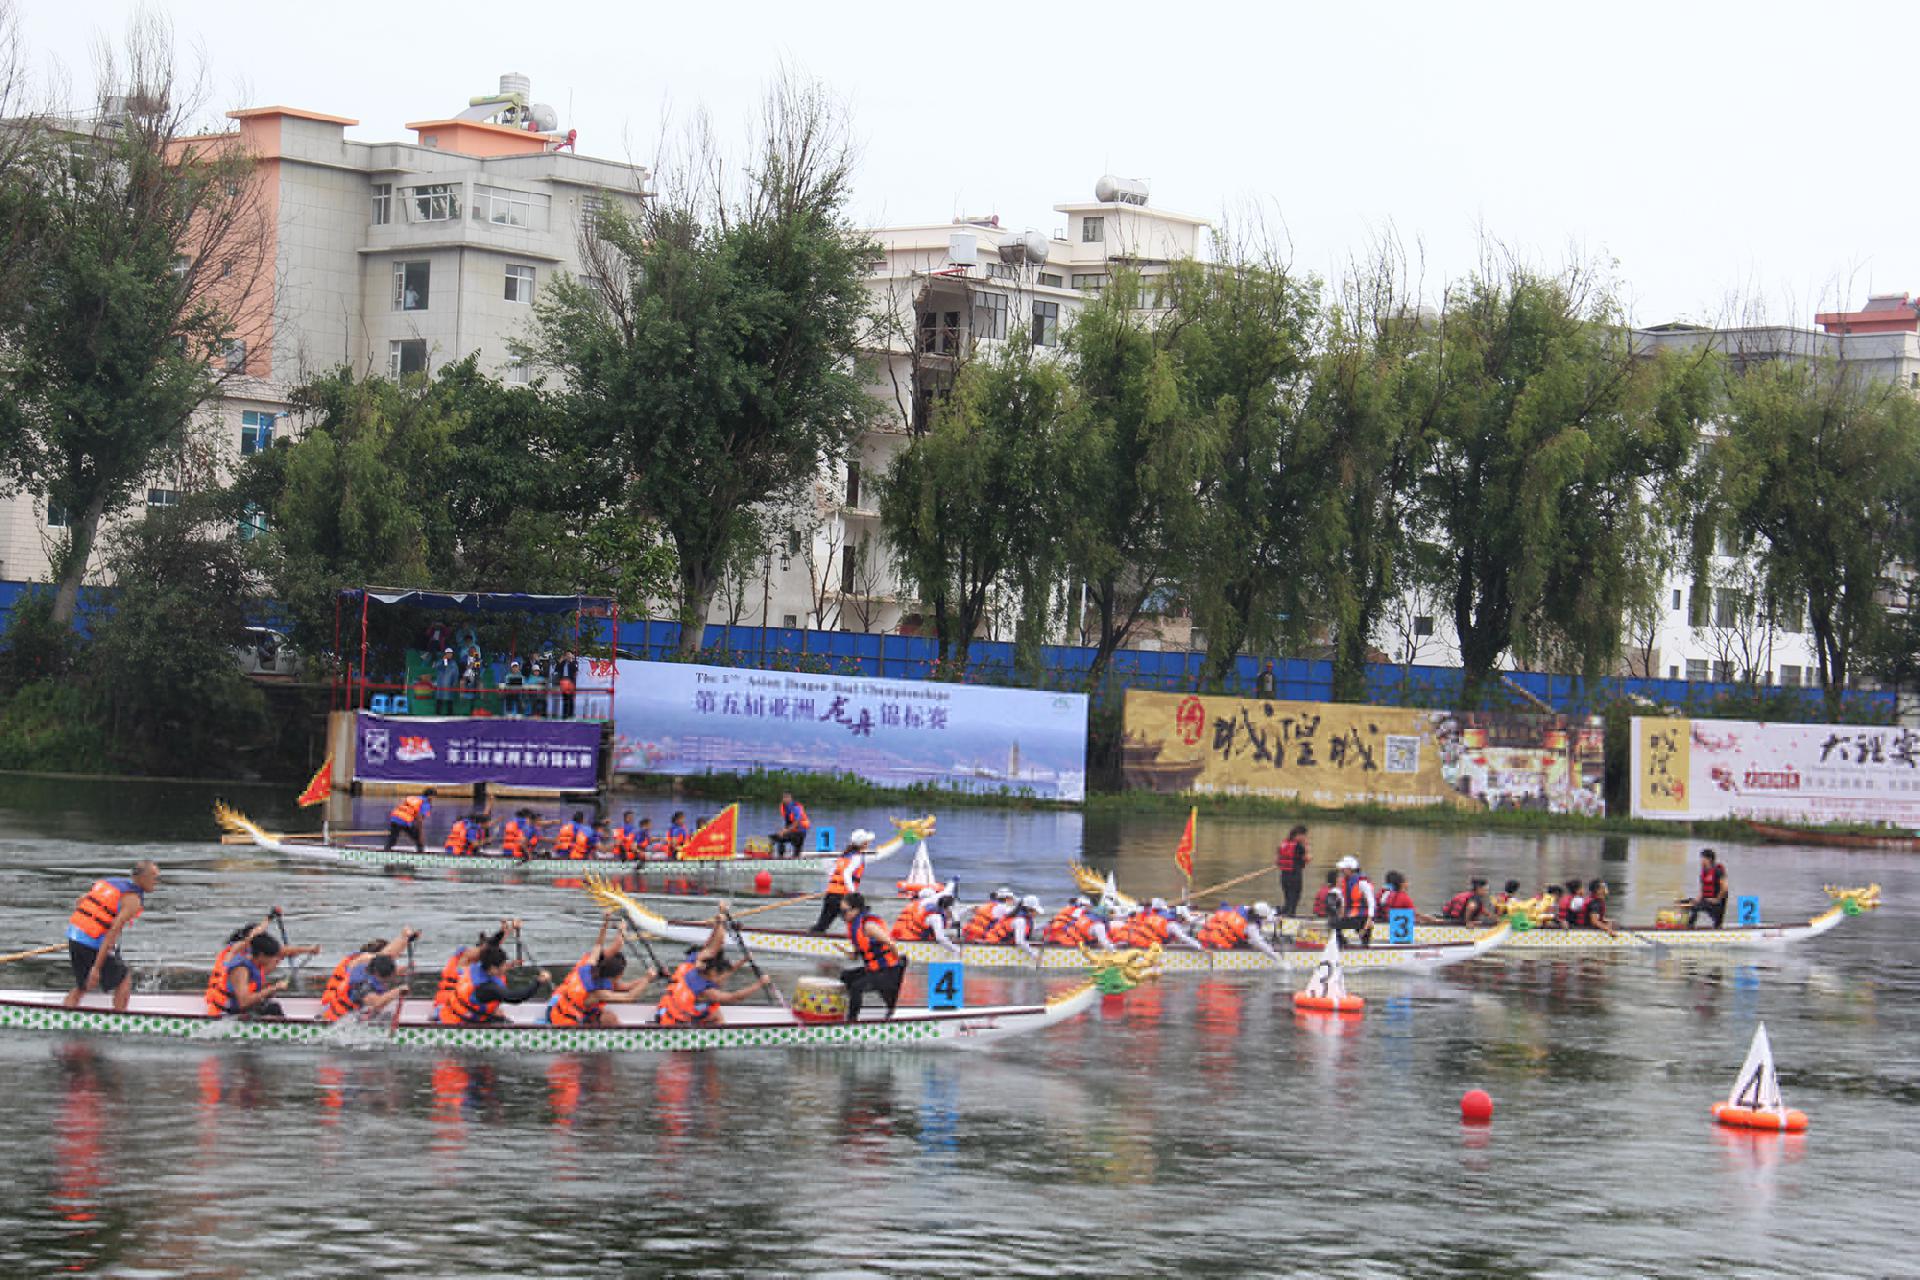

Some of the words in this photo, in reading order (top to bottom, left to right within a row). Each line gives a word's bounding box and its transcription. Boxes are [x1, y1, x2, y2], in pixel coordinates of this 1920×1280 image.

[1742, 901, 1756, 923] 2
[1393, 915, 1409, 938] 3
[934, 970, 958, 1000] 4
[1735, 1062, 1765, 1113] 4
